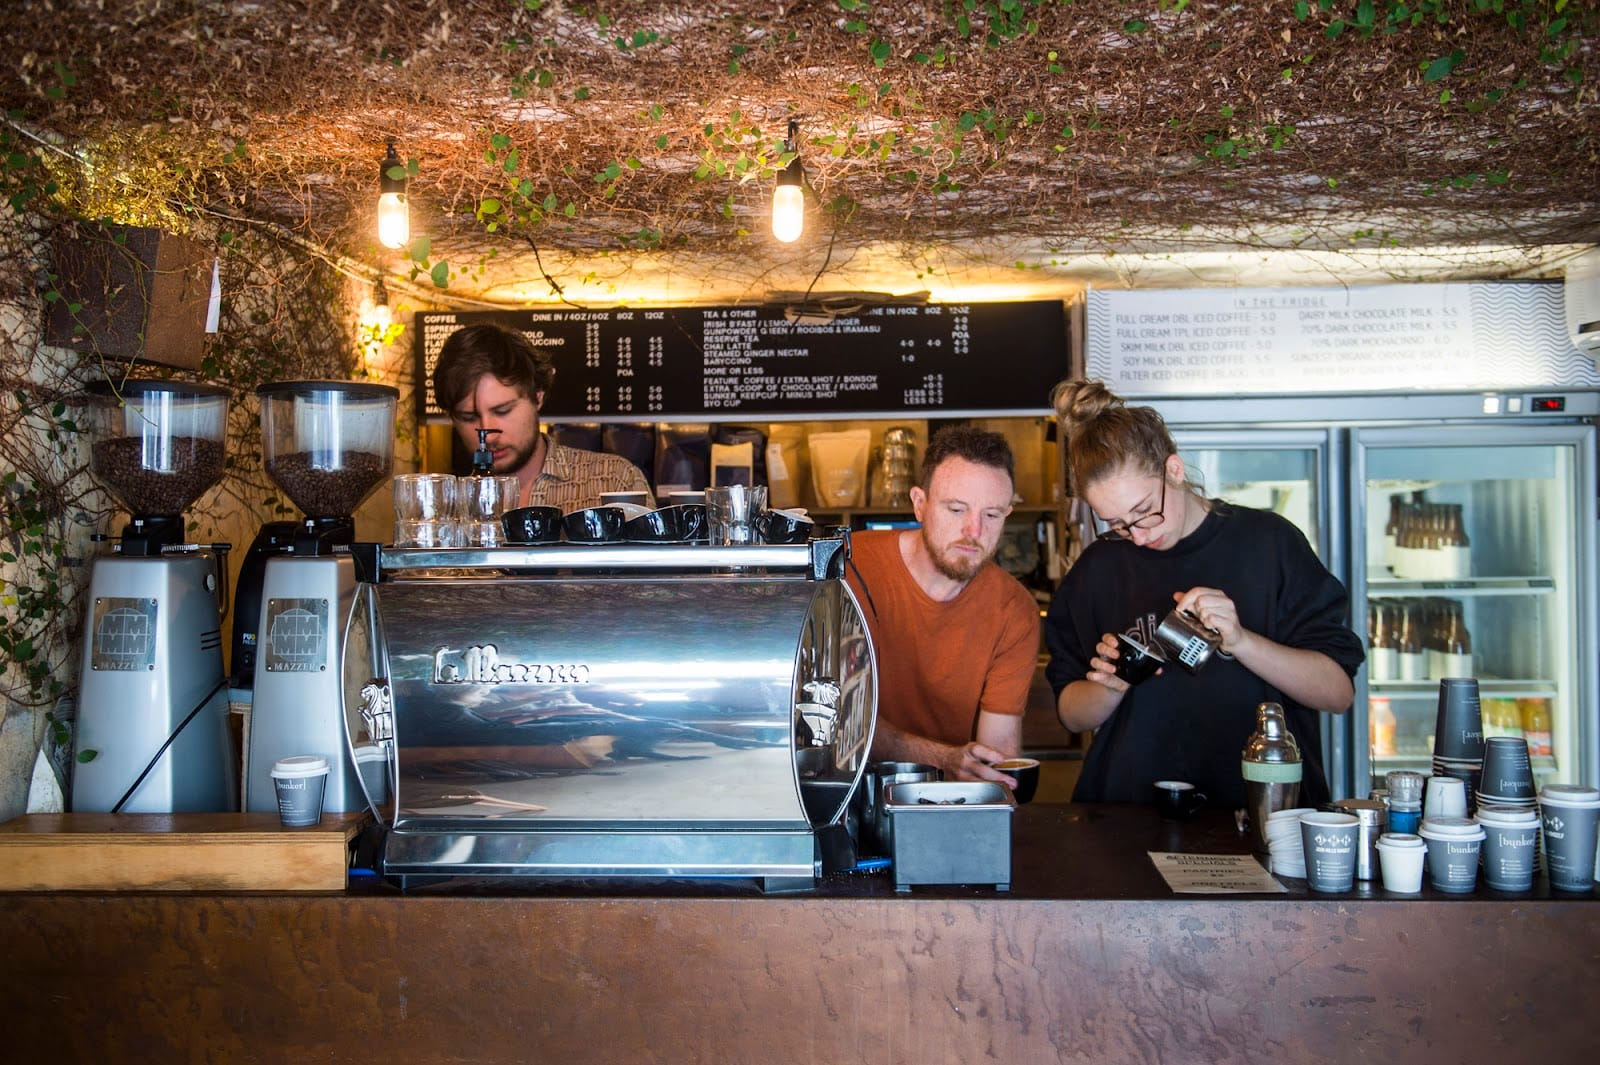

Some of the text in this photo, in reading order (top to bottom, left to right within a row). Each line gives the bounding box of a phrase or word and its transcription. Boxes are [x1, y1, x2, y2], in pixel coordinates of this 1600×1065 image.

[533, 313, 552, 322] DINE
[554, 313, 563, 321] IN
[645, 311, 665, 320] 12OZ
[702, 310, 719, 319] TEA
[729, 310, 757, 318] OTHER
[1115, 314, 1137, 325] FULL
[1139, 313, 1170, 324] CREAM
[1172, 313, 1189, 324] DBL
[1193, 313, 1215, 323] ICED
[1215, 312, 1251, 323] COFFEE
[1328, 310, 1350, 320] MILK
[1352, 308, 1407, 320] CHOCOLATE
[424, 315, 456, 324] COFFEE
[703, 320, 726, 328] IRISH
[703, 327, 757, 336] GUNPOWDER
[796, 326, 834, 334] ROOIBOS
[1116, 328, 1138, 338] FULL
[1140, 328, 1171, 338] CREAM
[1193, 327, 1214, 337] ICED
[1215, 326, 1250, 337] COFFEE
[1352, 322, 1407, 333] CHOCOLATE
[703, 335, 740, 343] RESERVE
[703, 342, 724, 351] CHAI
[727, 342, 752, 350] LATTE
[1189, 341, 1210, 352] ICED
[1211, 340, 1248, 351] COFFEE
[703, 349, 809, 358] STEAMED GINGER NECTAR
[703, 357, 752, 366] BABYCCINO
[1123, 356, 1141, 367] SOY
[617, 369, 634, 378] POA
[703, 367, 764, 375] MORE OR LESS
[703, 377, 739, 385] FEATURE
[743, 376, 776, 384] COFFEE
[783, 376, 809, 384] EXTRA
[811, 375, 834, 383] SHOT
[703, 385, 730, 393] EXTRA
[733, 384, 763, 393] SCOOP
[766, 384, 777, 392] OF
[780, 384, 831, 392] CHOCOLATE
[839, 383, 878, 391] FLAVOUR
[703, 392, 737, 400] BUNKER
[740, 391, 778, 400] KEEPCUP
[786, 391, 812, 399] MINUS
[815, 390, 838, 399] SHOT
[904, 389, 926, 397] LESS
[703, 399, 721, 408] BYO
[723, 398, 741, 408] CUP
[904, 396, 926, 405] LESS
